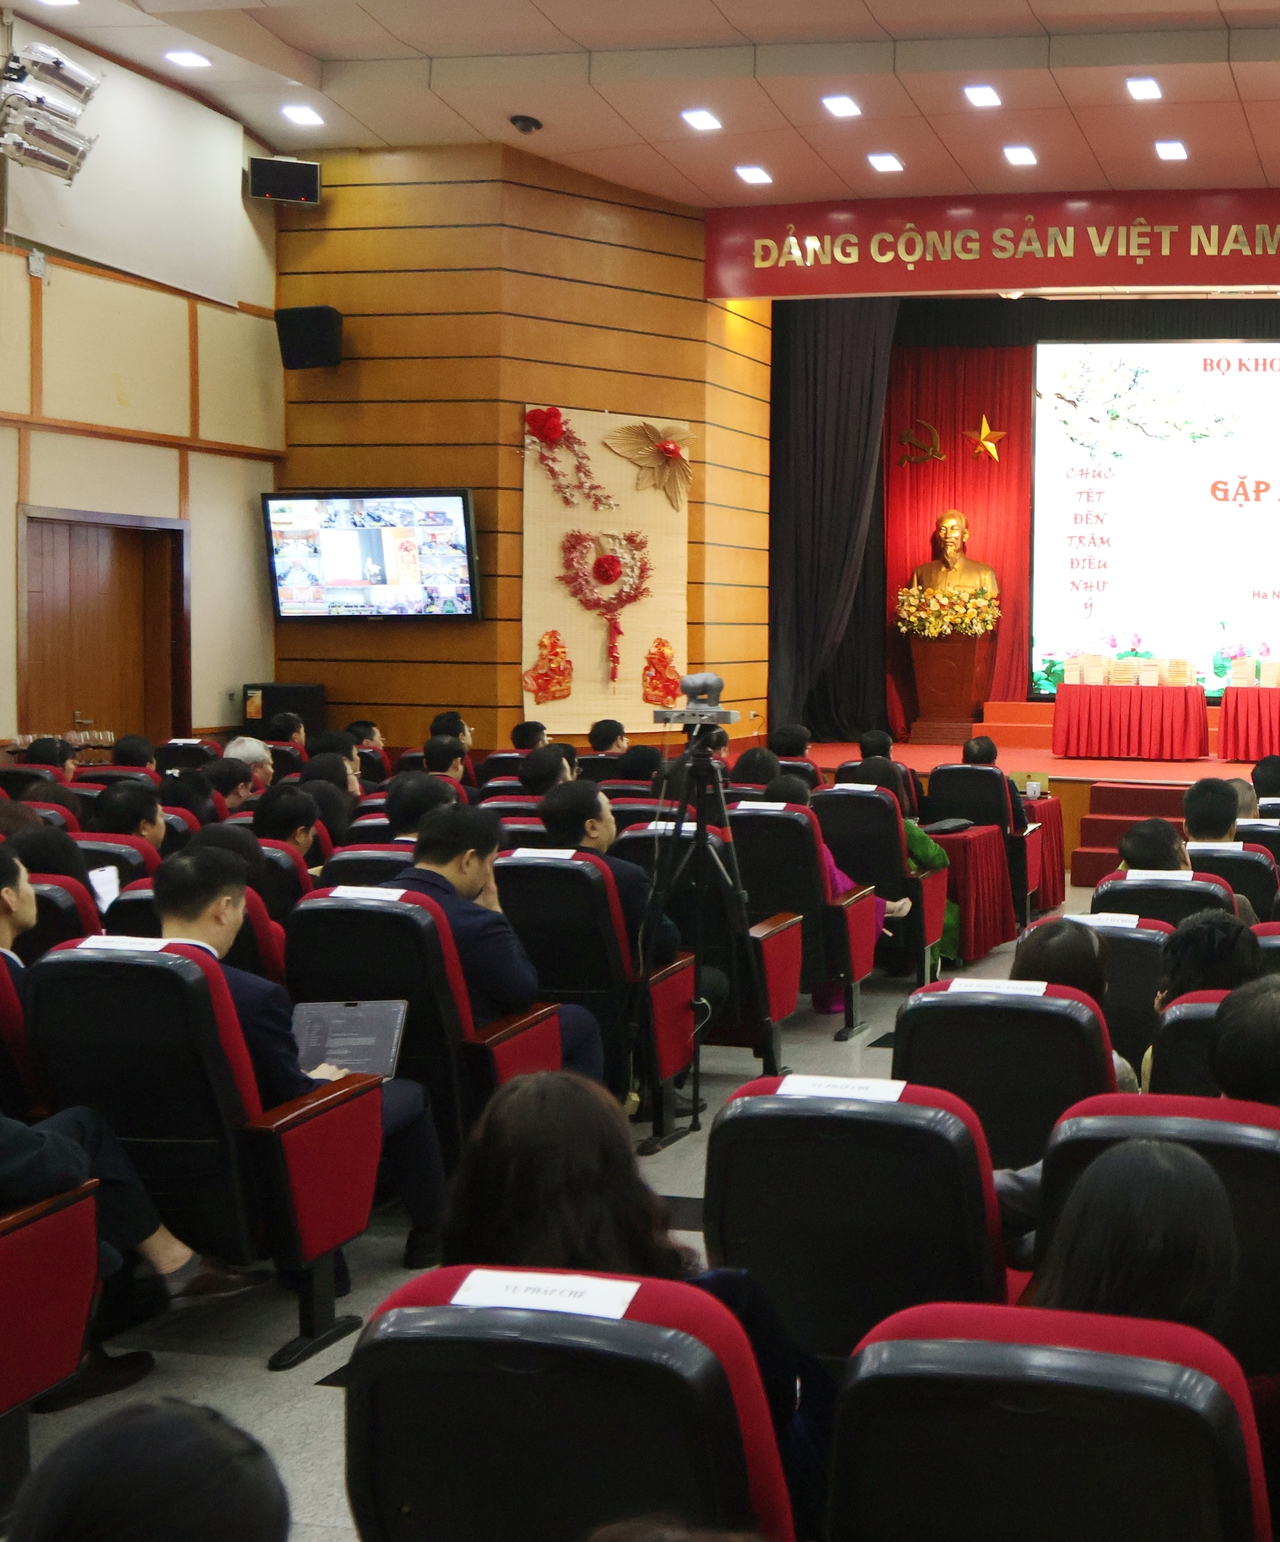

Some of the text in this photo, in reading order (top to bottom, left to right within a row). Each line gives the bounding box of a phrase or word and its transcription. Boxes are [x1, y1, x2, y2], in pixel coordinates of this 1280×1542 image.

[752, 224, 860, 269] ĐẢNG
[870, 223, 981, 271] CỘNG
[993, 214, 1075, 260] SẢN
[1087, 217, 1180, 265] VIỆT
[1202, 355, 1232, 376] BỘ
[1210, 474, 1272, 508] GẶP
[1252, 589, 1269, 600] Hà
